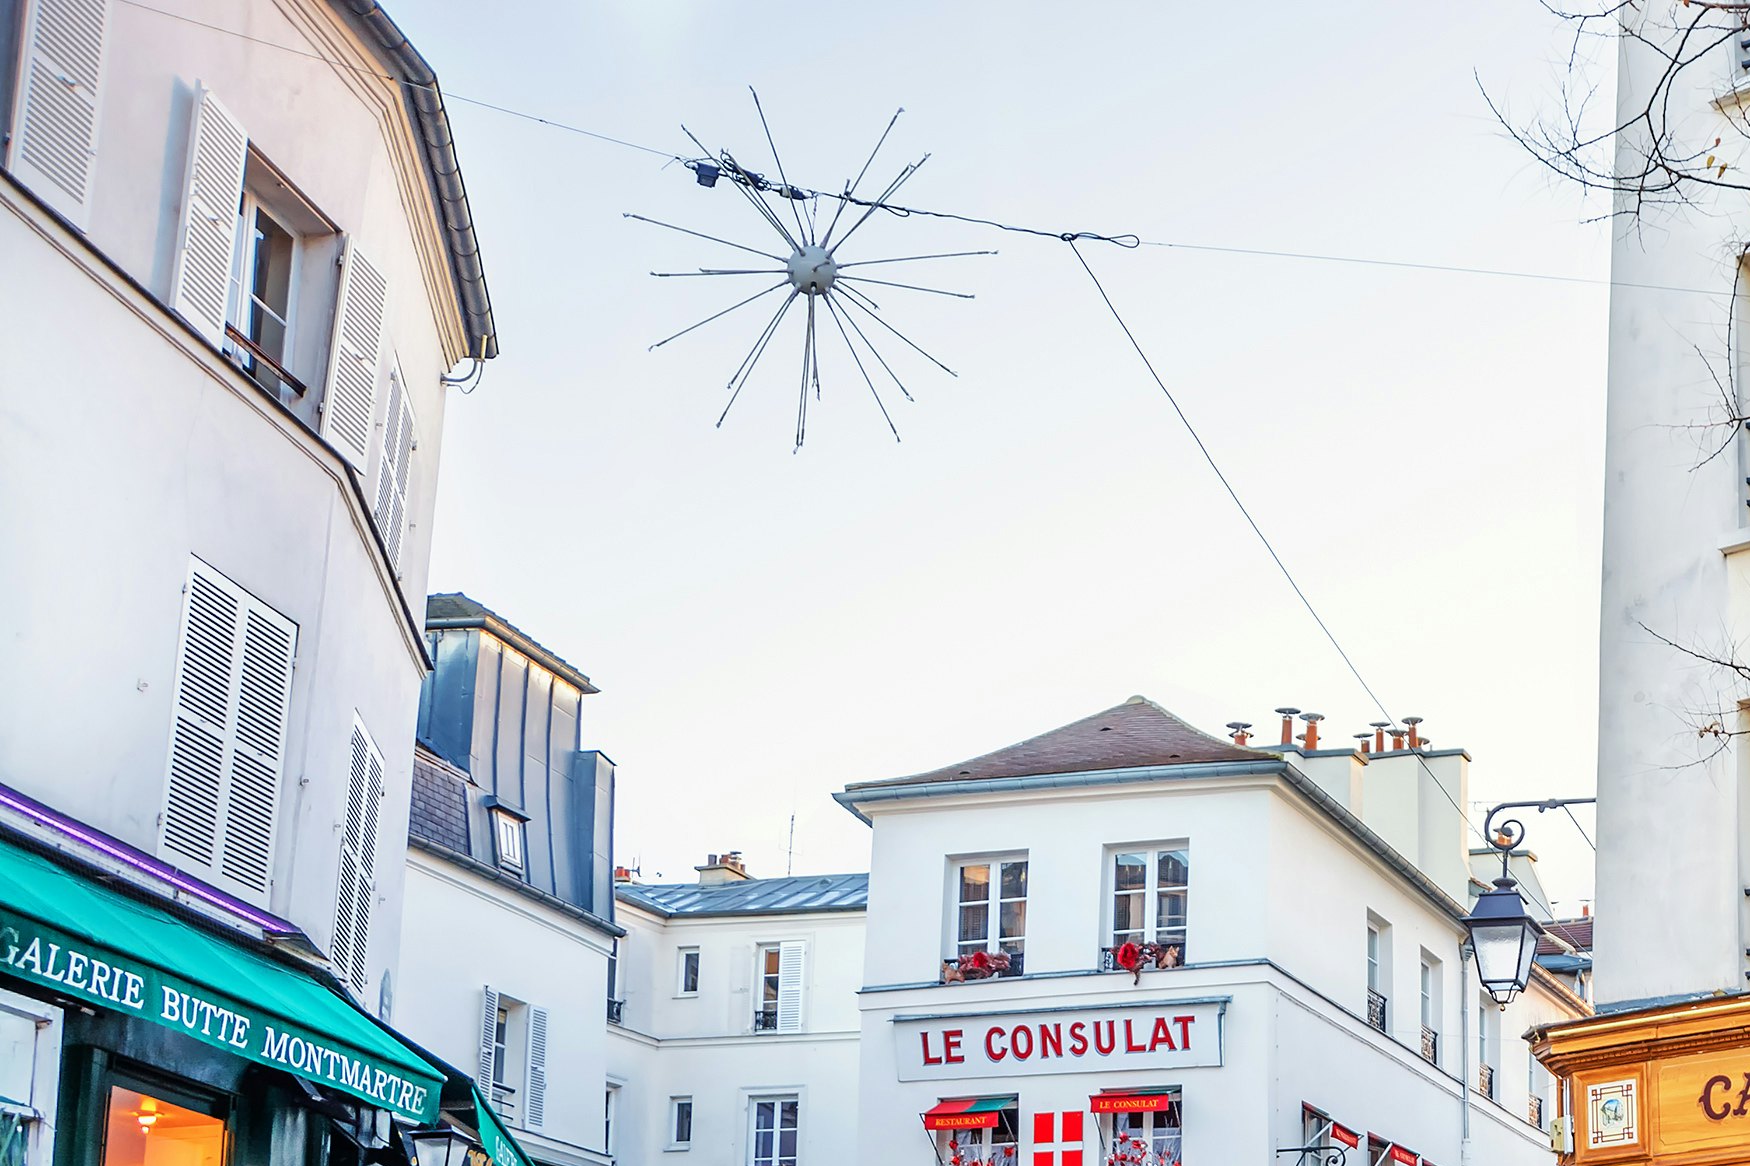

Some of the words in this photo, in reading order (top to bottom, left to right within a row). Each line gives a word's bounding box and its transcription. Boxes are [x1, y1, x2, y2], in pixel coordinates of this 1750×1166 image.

[0, 926, 145, 1010] GALERIE
[160, 985, 250, 1049] BUTTE
[261, 1026, 427, 1115] MONTMARTRE
[920, 1029, 965, 1066] LE
[984, 1015, 1195, 1062] CONSULAT
[1100, 1101, 1110, 1109] LE
[1113, 1099, 1159, 1108] CONSULAT
[935, 1116, 986, 1126] RESTAURANT
